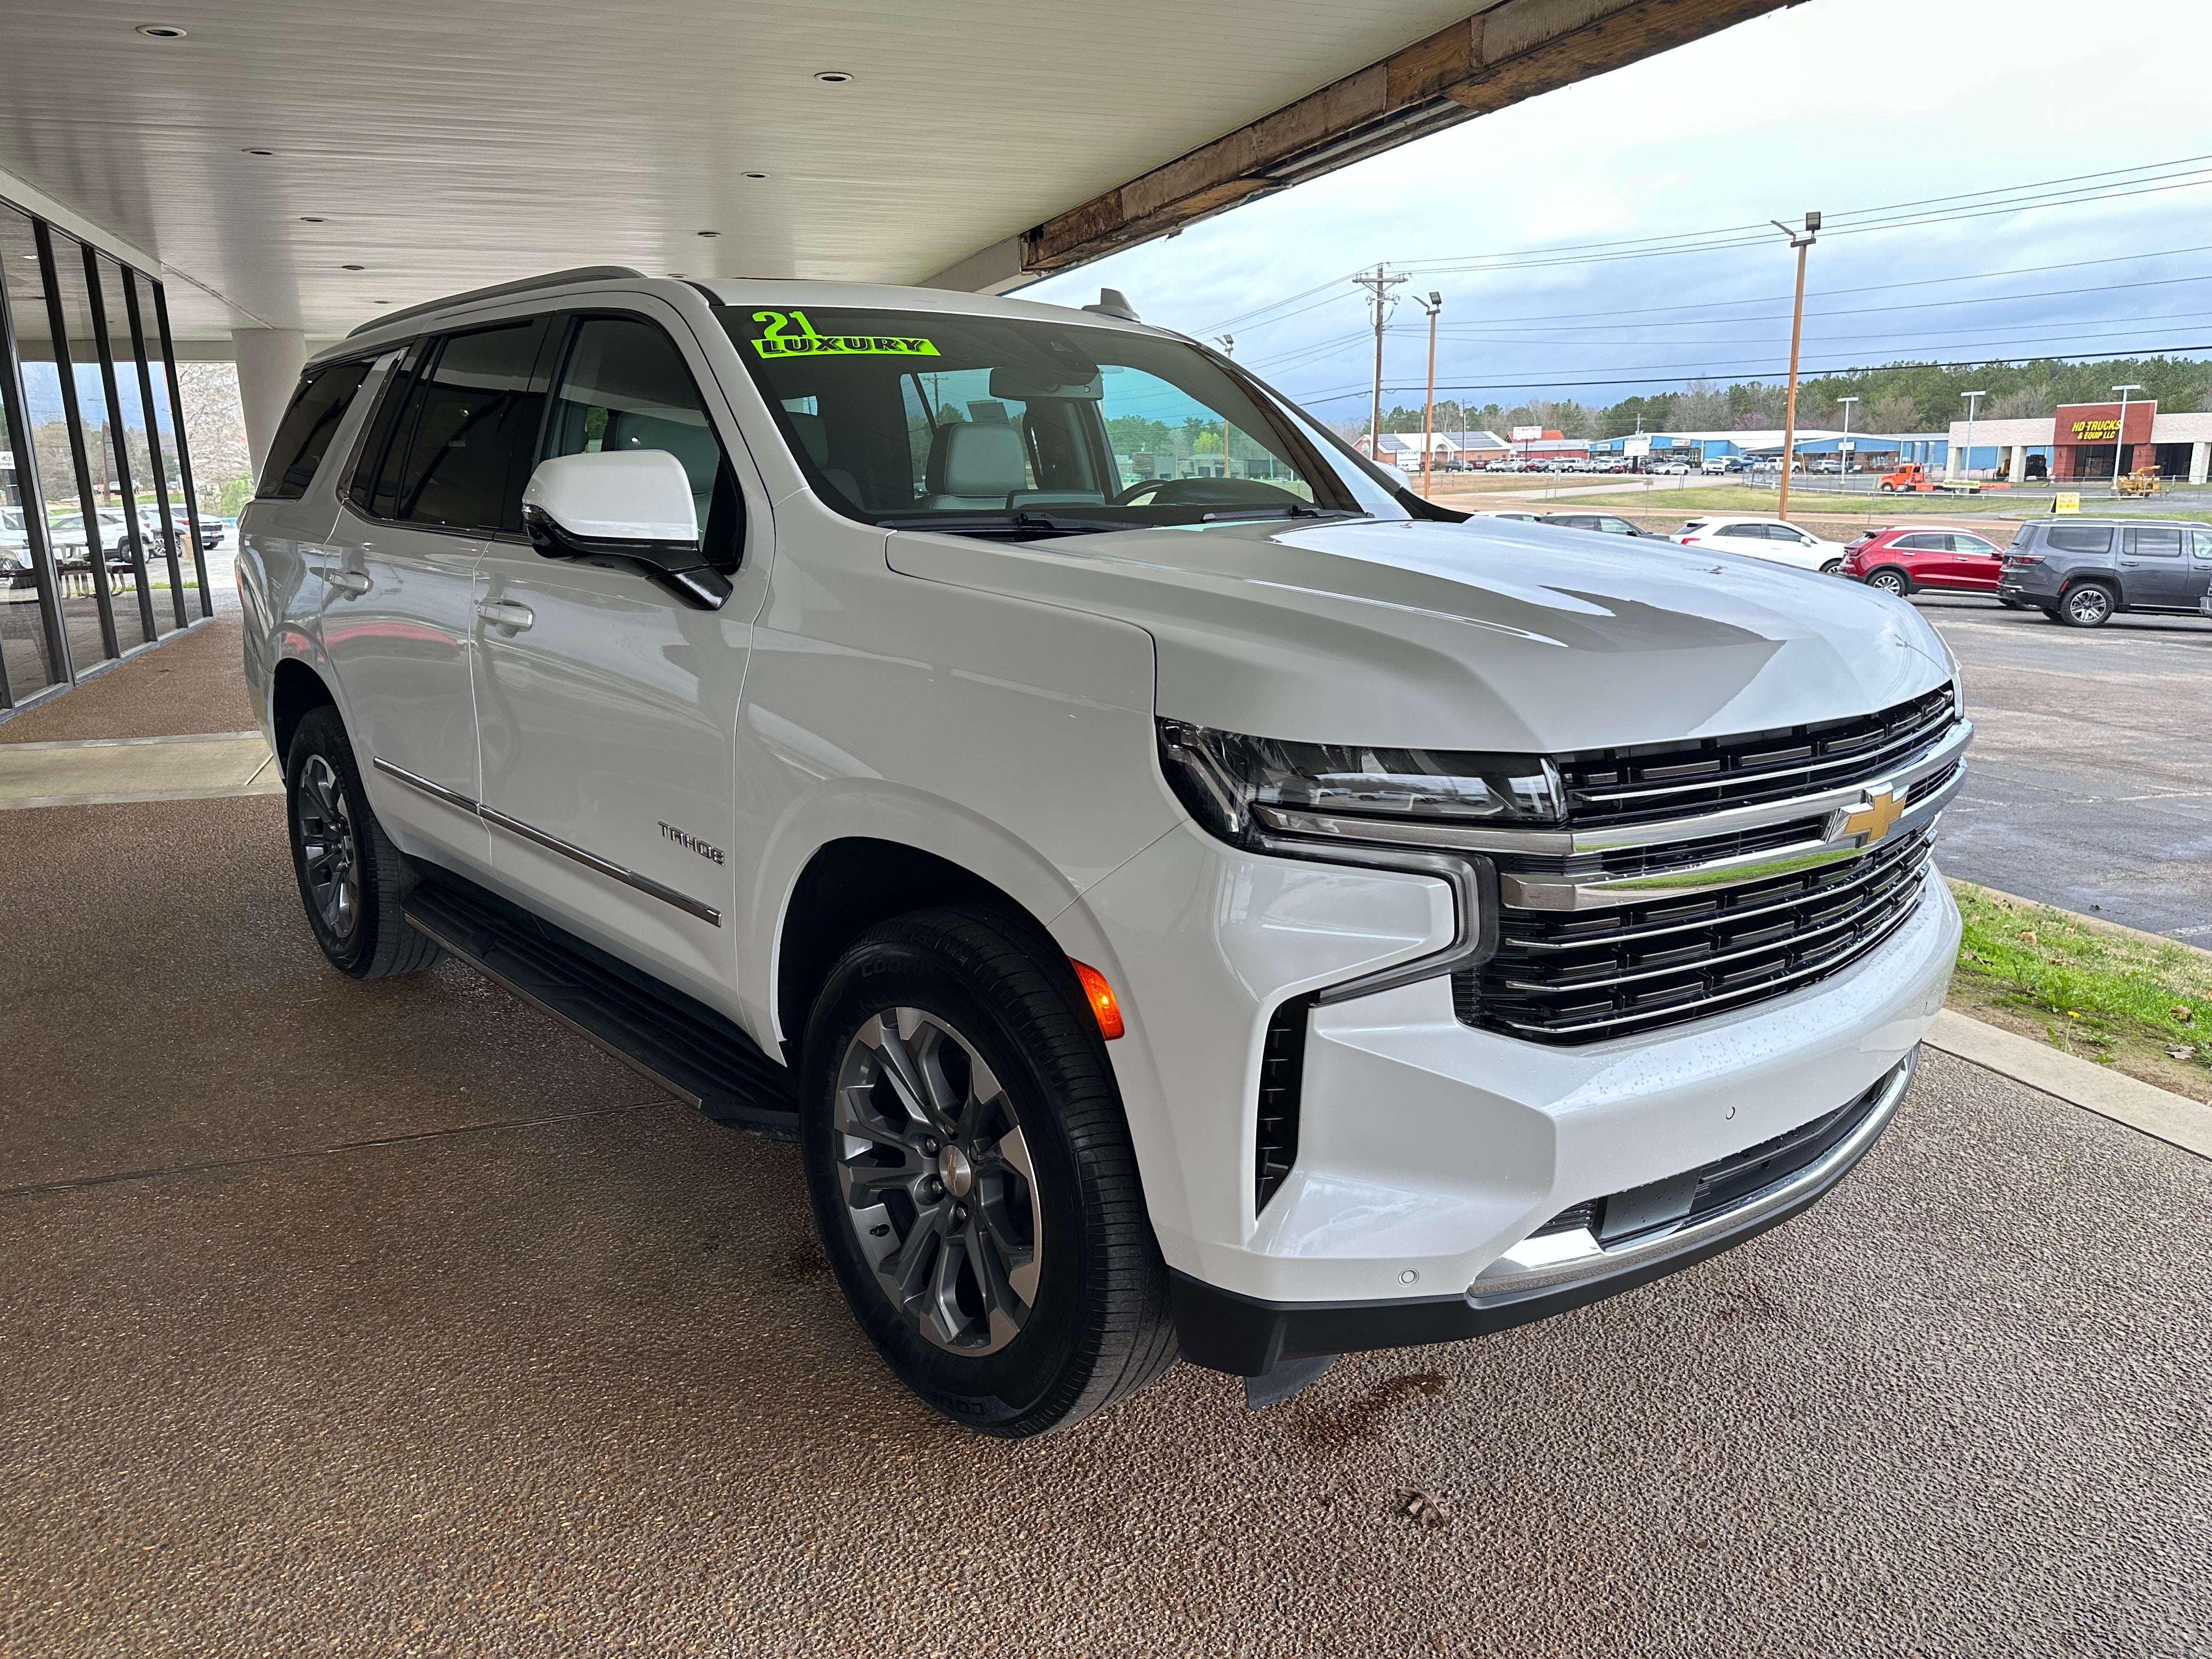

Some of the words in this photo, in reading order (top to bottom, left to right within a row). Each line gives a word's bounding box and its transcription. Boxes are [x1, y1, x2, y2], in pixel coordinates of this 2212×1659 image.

[752, 311, 822, 338] 21
[761, 337, 924, 354] LUXURY
[2084, 431, 2103, 440] EQUIP
[658, 820, 726, 866] TAHOE
